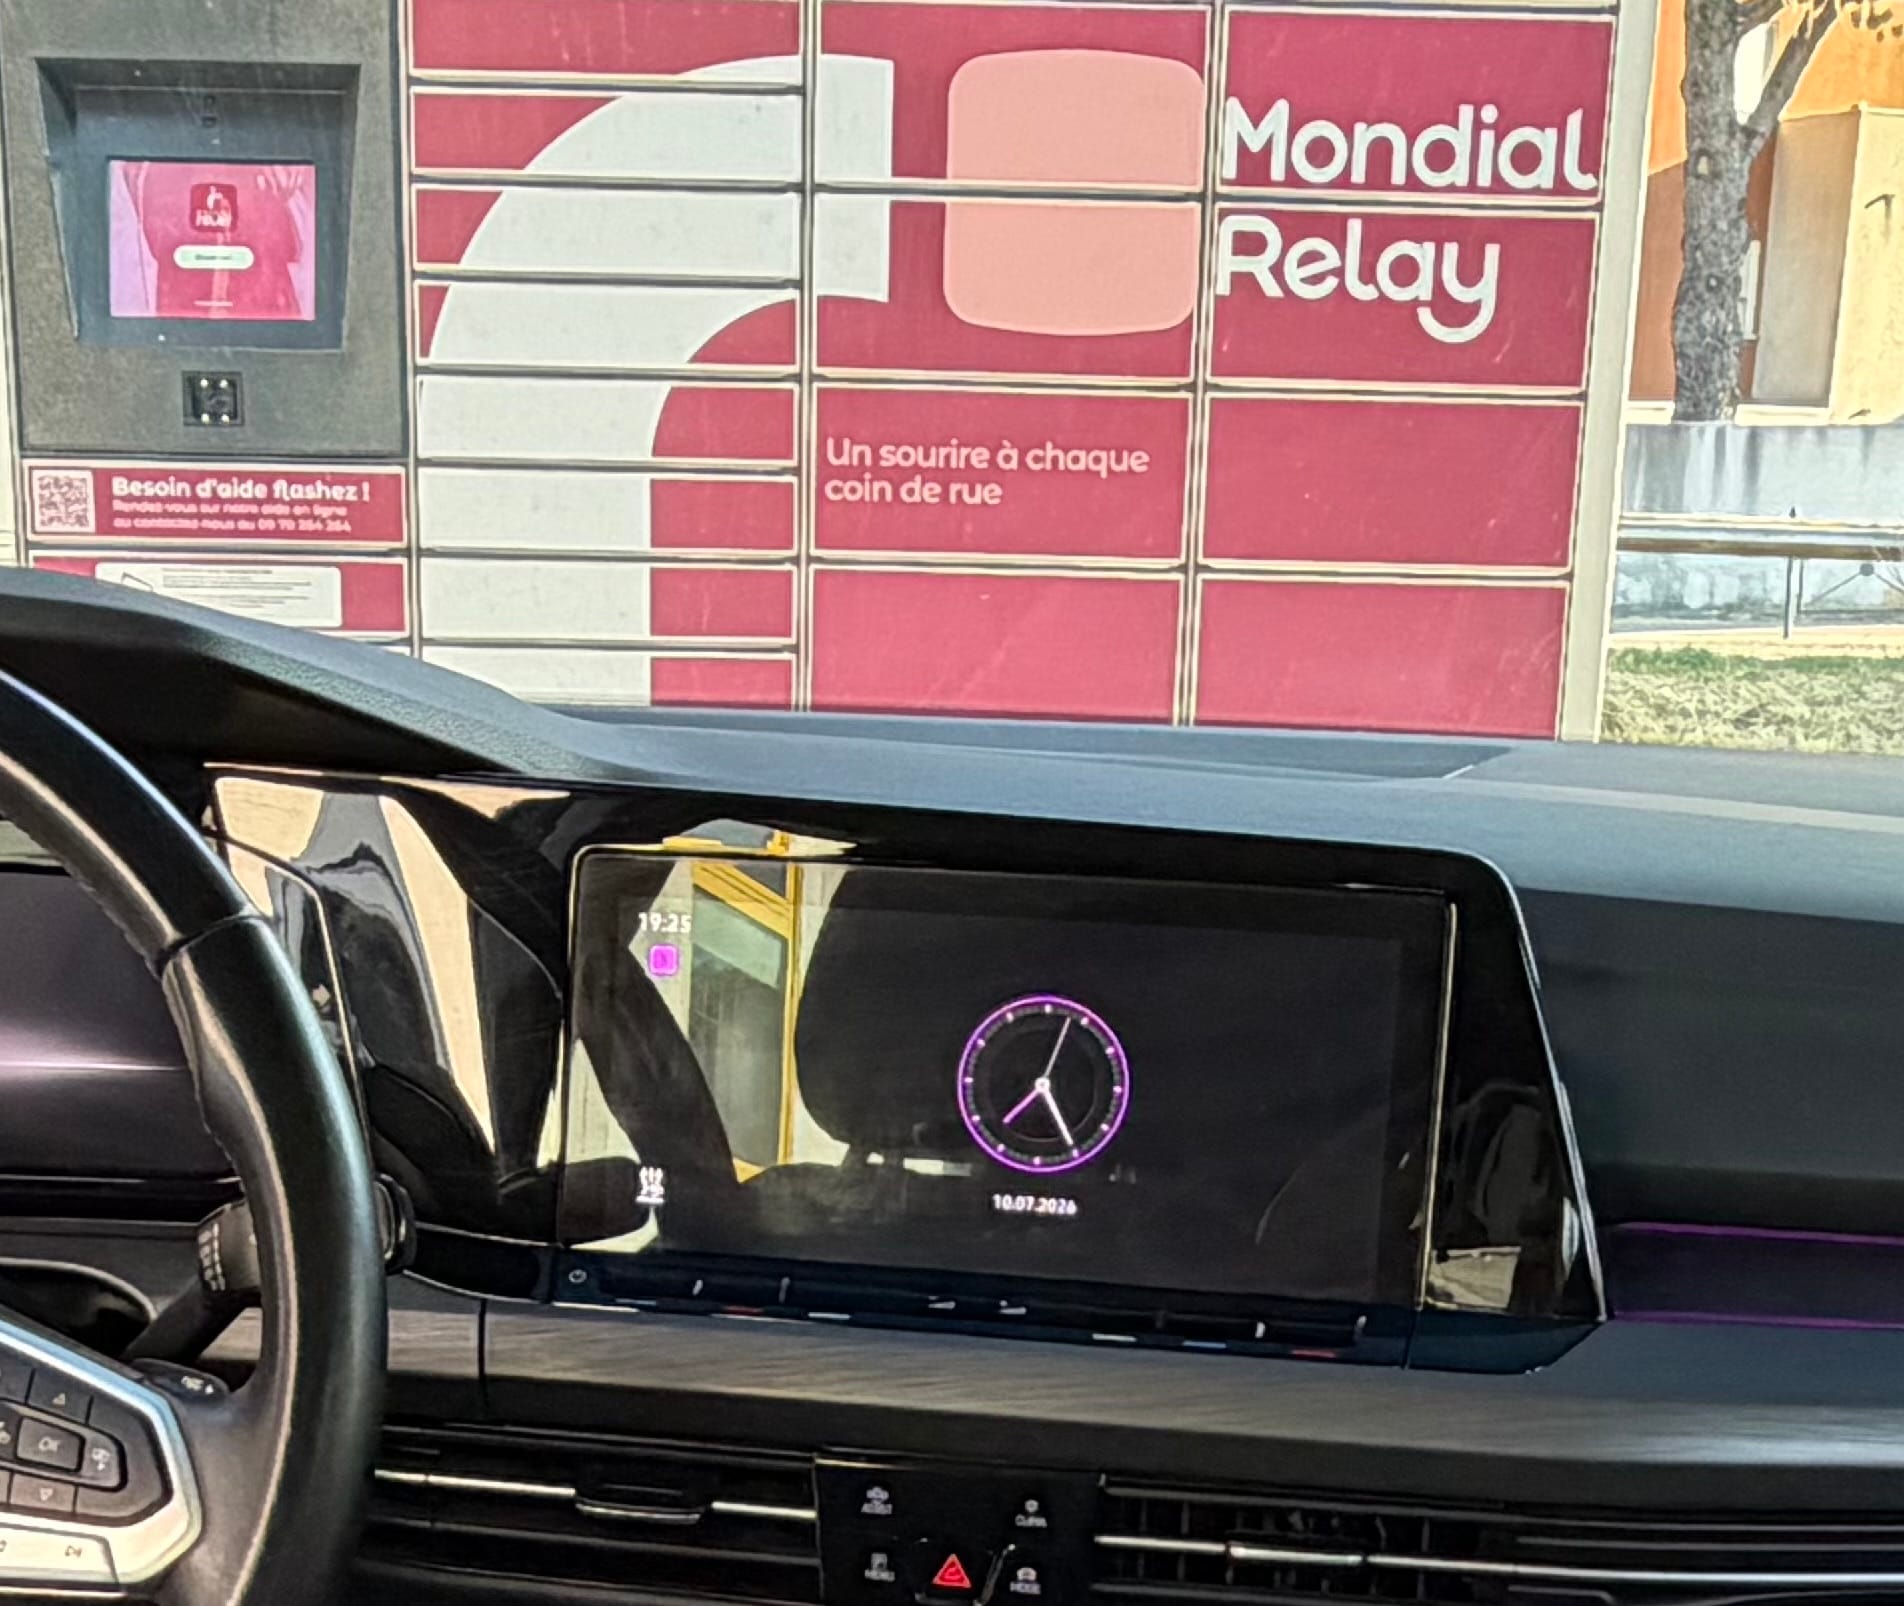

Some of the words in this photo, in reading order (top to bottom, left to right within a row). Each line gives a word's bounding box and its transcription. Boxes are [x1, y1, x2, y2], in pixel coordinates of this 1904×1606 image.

[1220, 95, 1599, 191] Mondial
[1214, 214, 1501, 344] Relay
[826, 437, 873, 467] Un
[879, 437, 989, 469] sourire
[996, 439, 1019, 471] à
[1025, 441, 1150, 479] chaque
[112, 476, 192, 497] Besoin
[196, 476, 268, 499] d'aide
[272, 478, 358, 501] flashez
[824, 472, 893, 503] coin
[899, 474, 942, 504] de
[949, 486, 1003, 505] rue
[638, 912, 692, 934] 19:25
[992, 1193, 1078, 1216] 10.07.2026
[38, 1436, 62, 1453] OK
